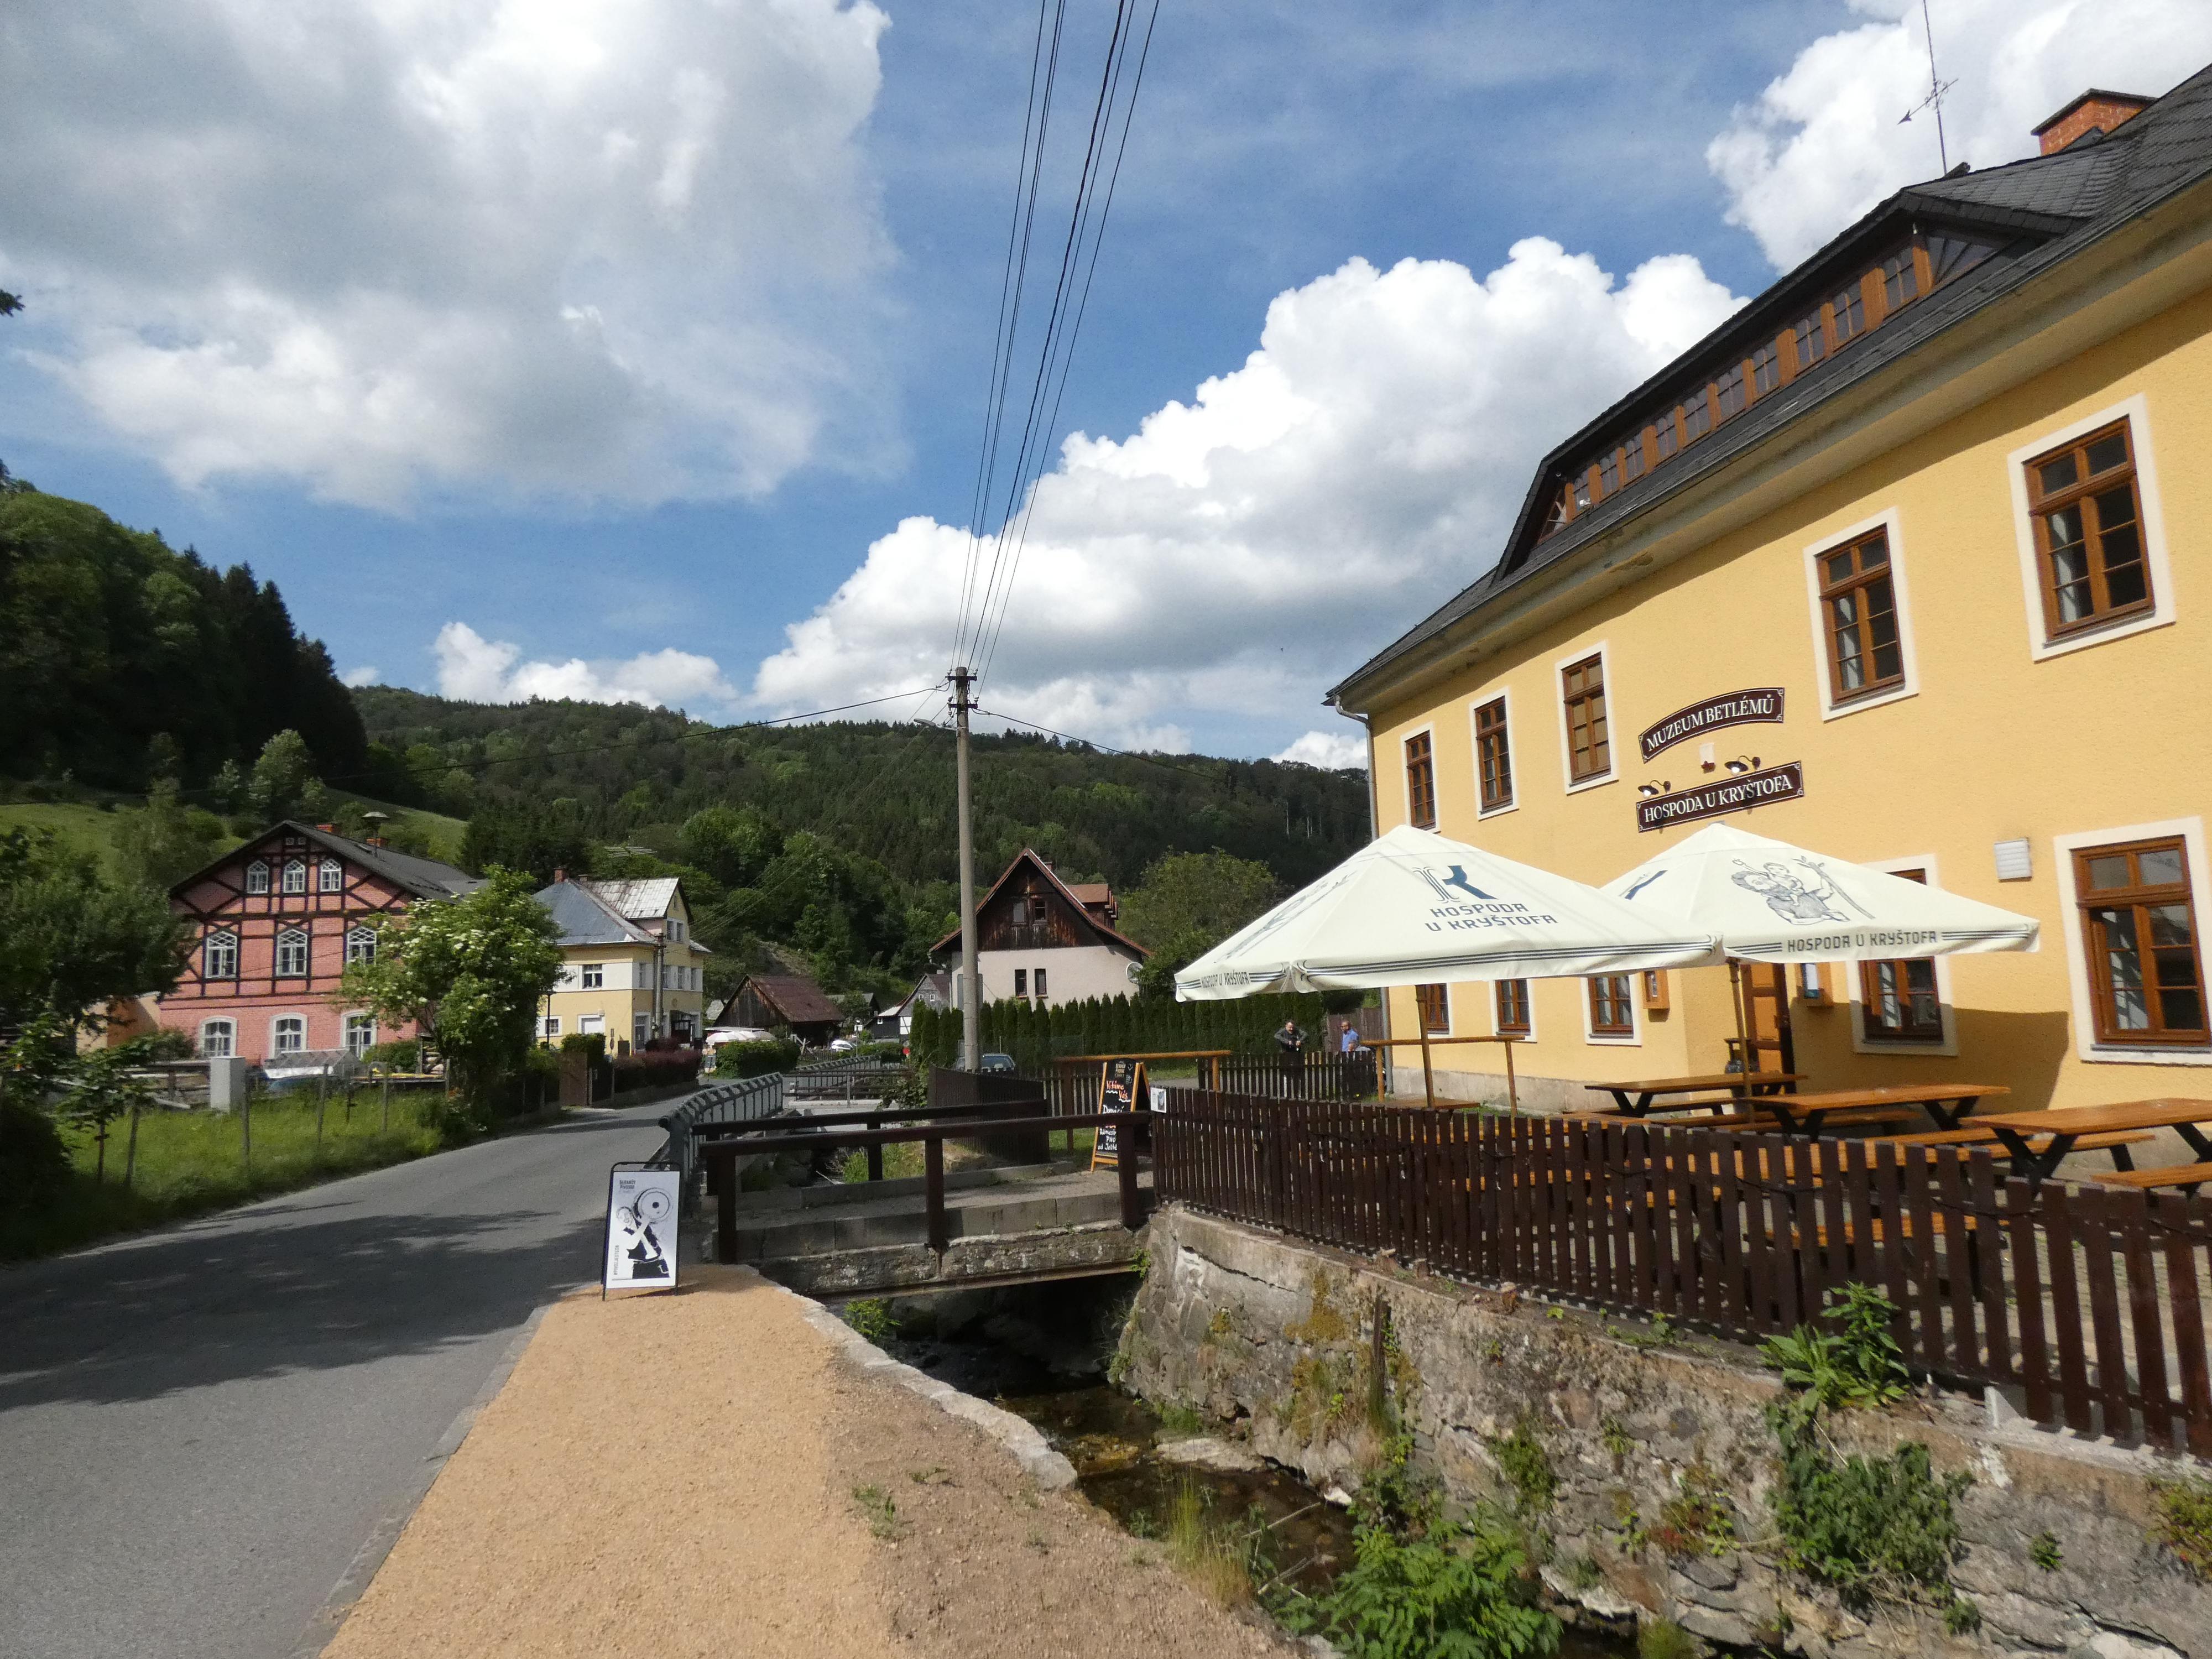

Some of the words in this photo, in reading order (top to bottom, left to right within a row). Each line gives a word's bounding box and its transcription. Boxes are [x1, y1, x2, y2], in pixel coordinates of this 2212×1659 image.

[1646, 712, 1704, 752] MUZEUM
[1705, 694, 1775, 723] BETLÉMŮ
[1645, 796, 1704, 822] HOSPODA
[1705, 794, 1716, 808] U
[1719, 774, 1793, 805] KRYŠTOFA
[1430, 903, 1529, 917] HOSPODA
[1425, 922, 1442, 932] U
[1447, 915, 1558, 930] KRYŠTOFA
[1788, 935, 1851, 952] HOSPODA
[1856, 934, 1864, 946] U
[1870, 930, 1937, 946] KRYŠTOFA
[1201, 973, 1218, 988] HOSPODA
[1219, 974, 1223, 986] U
[1224, 969, 1249, 986] KRYŠTOFA
[1119, 1090, 1128, 1100] Vás
